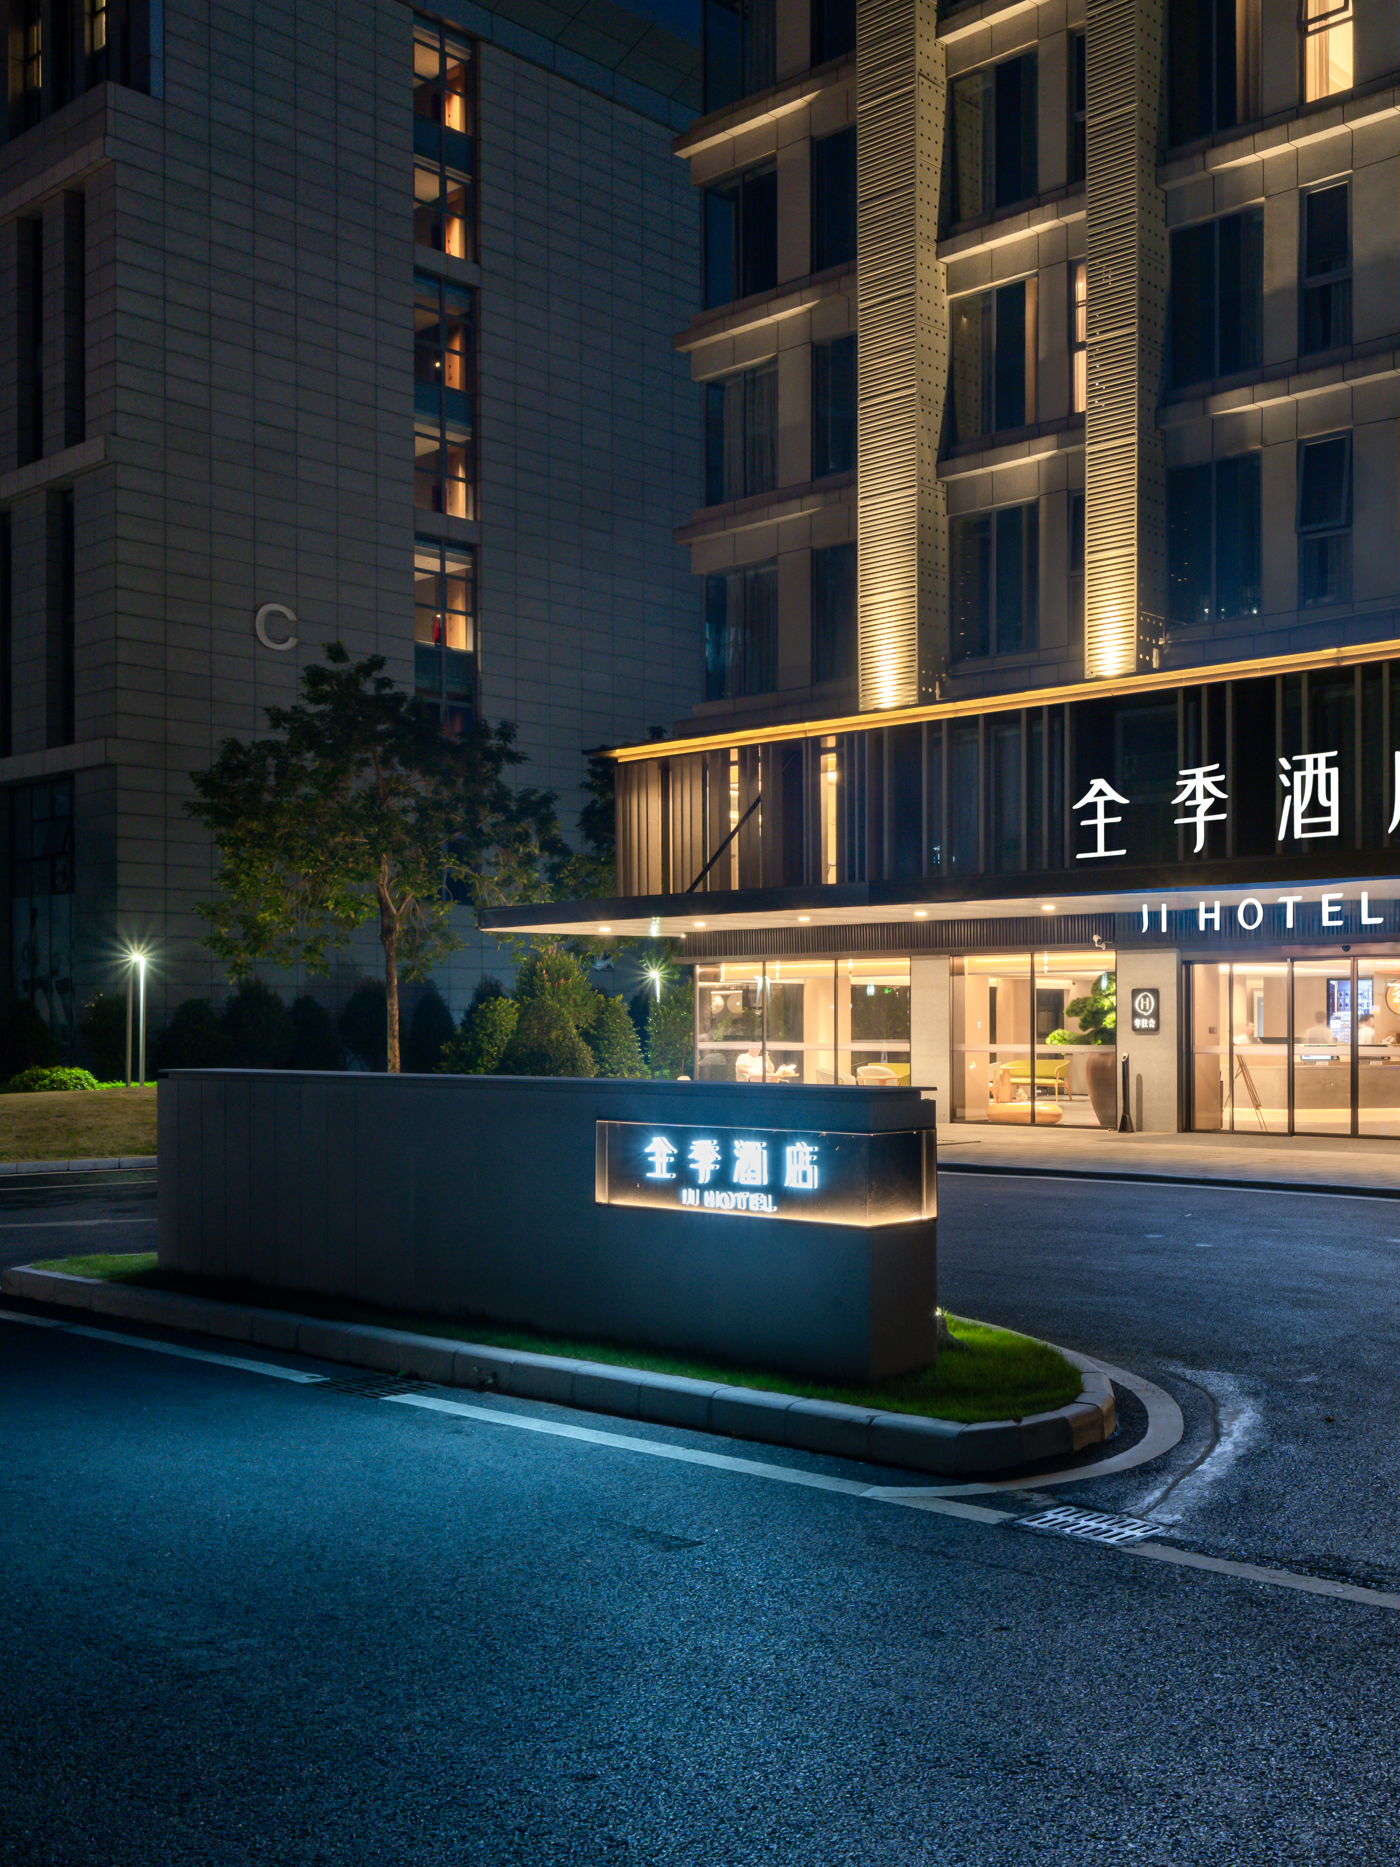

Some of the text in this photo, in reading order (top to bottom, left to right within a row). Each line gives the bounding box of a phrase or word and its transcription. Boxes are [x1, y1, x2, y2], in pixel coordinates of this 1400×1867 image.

[256, 603, 298, 651] C
[1141, 892, 1384, 933] JI HOTEL
[644, 1136, 818, 1189] 全季酒店
[704, 1190, 777, 1213] HOTEL
